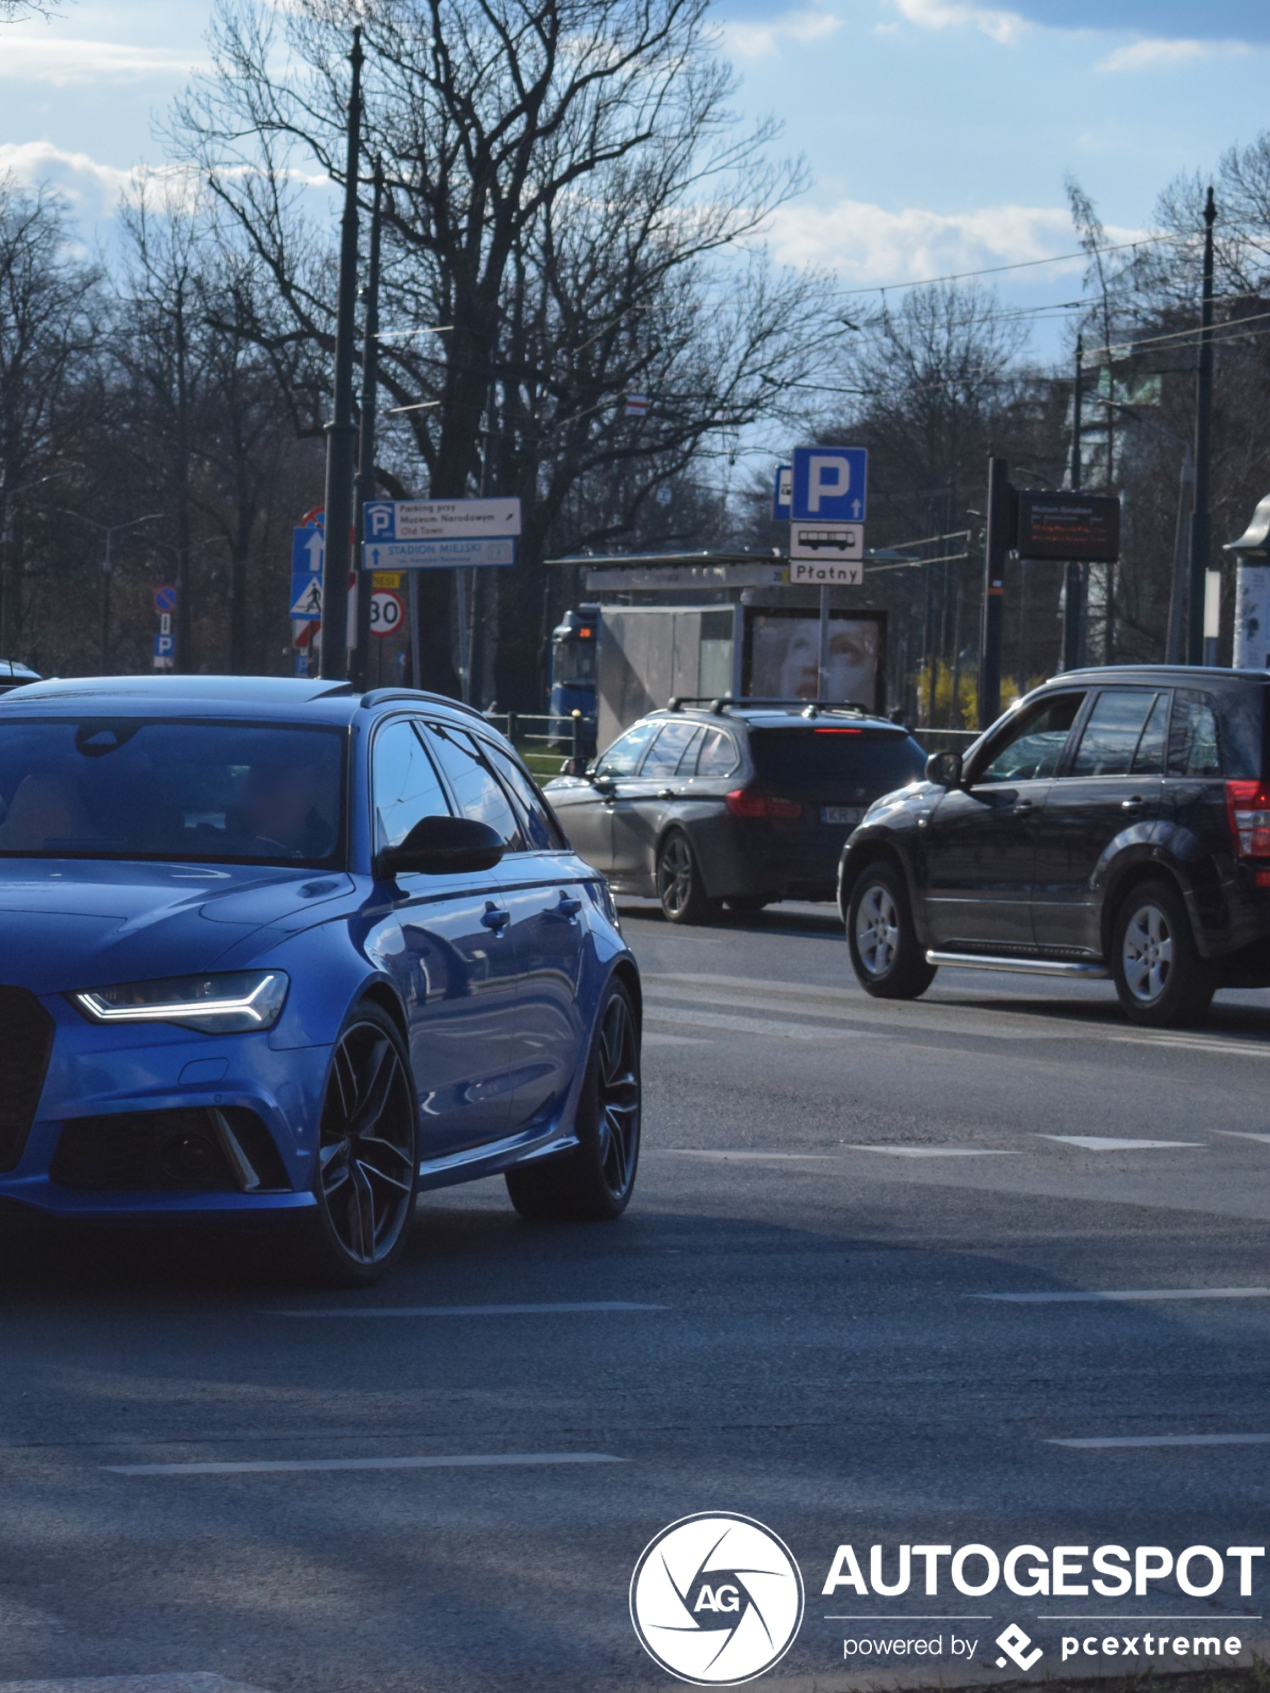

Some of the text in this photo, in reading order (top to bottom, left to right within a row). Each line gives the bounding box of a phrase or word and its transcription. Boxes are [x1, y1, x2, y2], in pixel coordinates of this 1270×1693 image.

[808, 455, 850, 512] P
[400, 504, 433, 513] Parking
[372, 512, 389, 536] P
[400, 514, 495, 524] Muzeum Narodowym
[400, 526, 443, 536] Old Town
[388, 543, 481, 556] STADION MIEJSKI
[796, 565, 857, 583] Płatny
